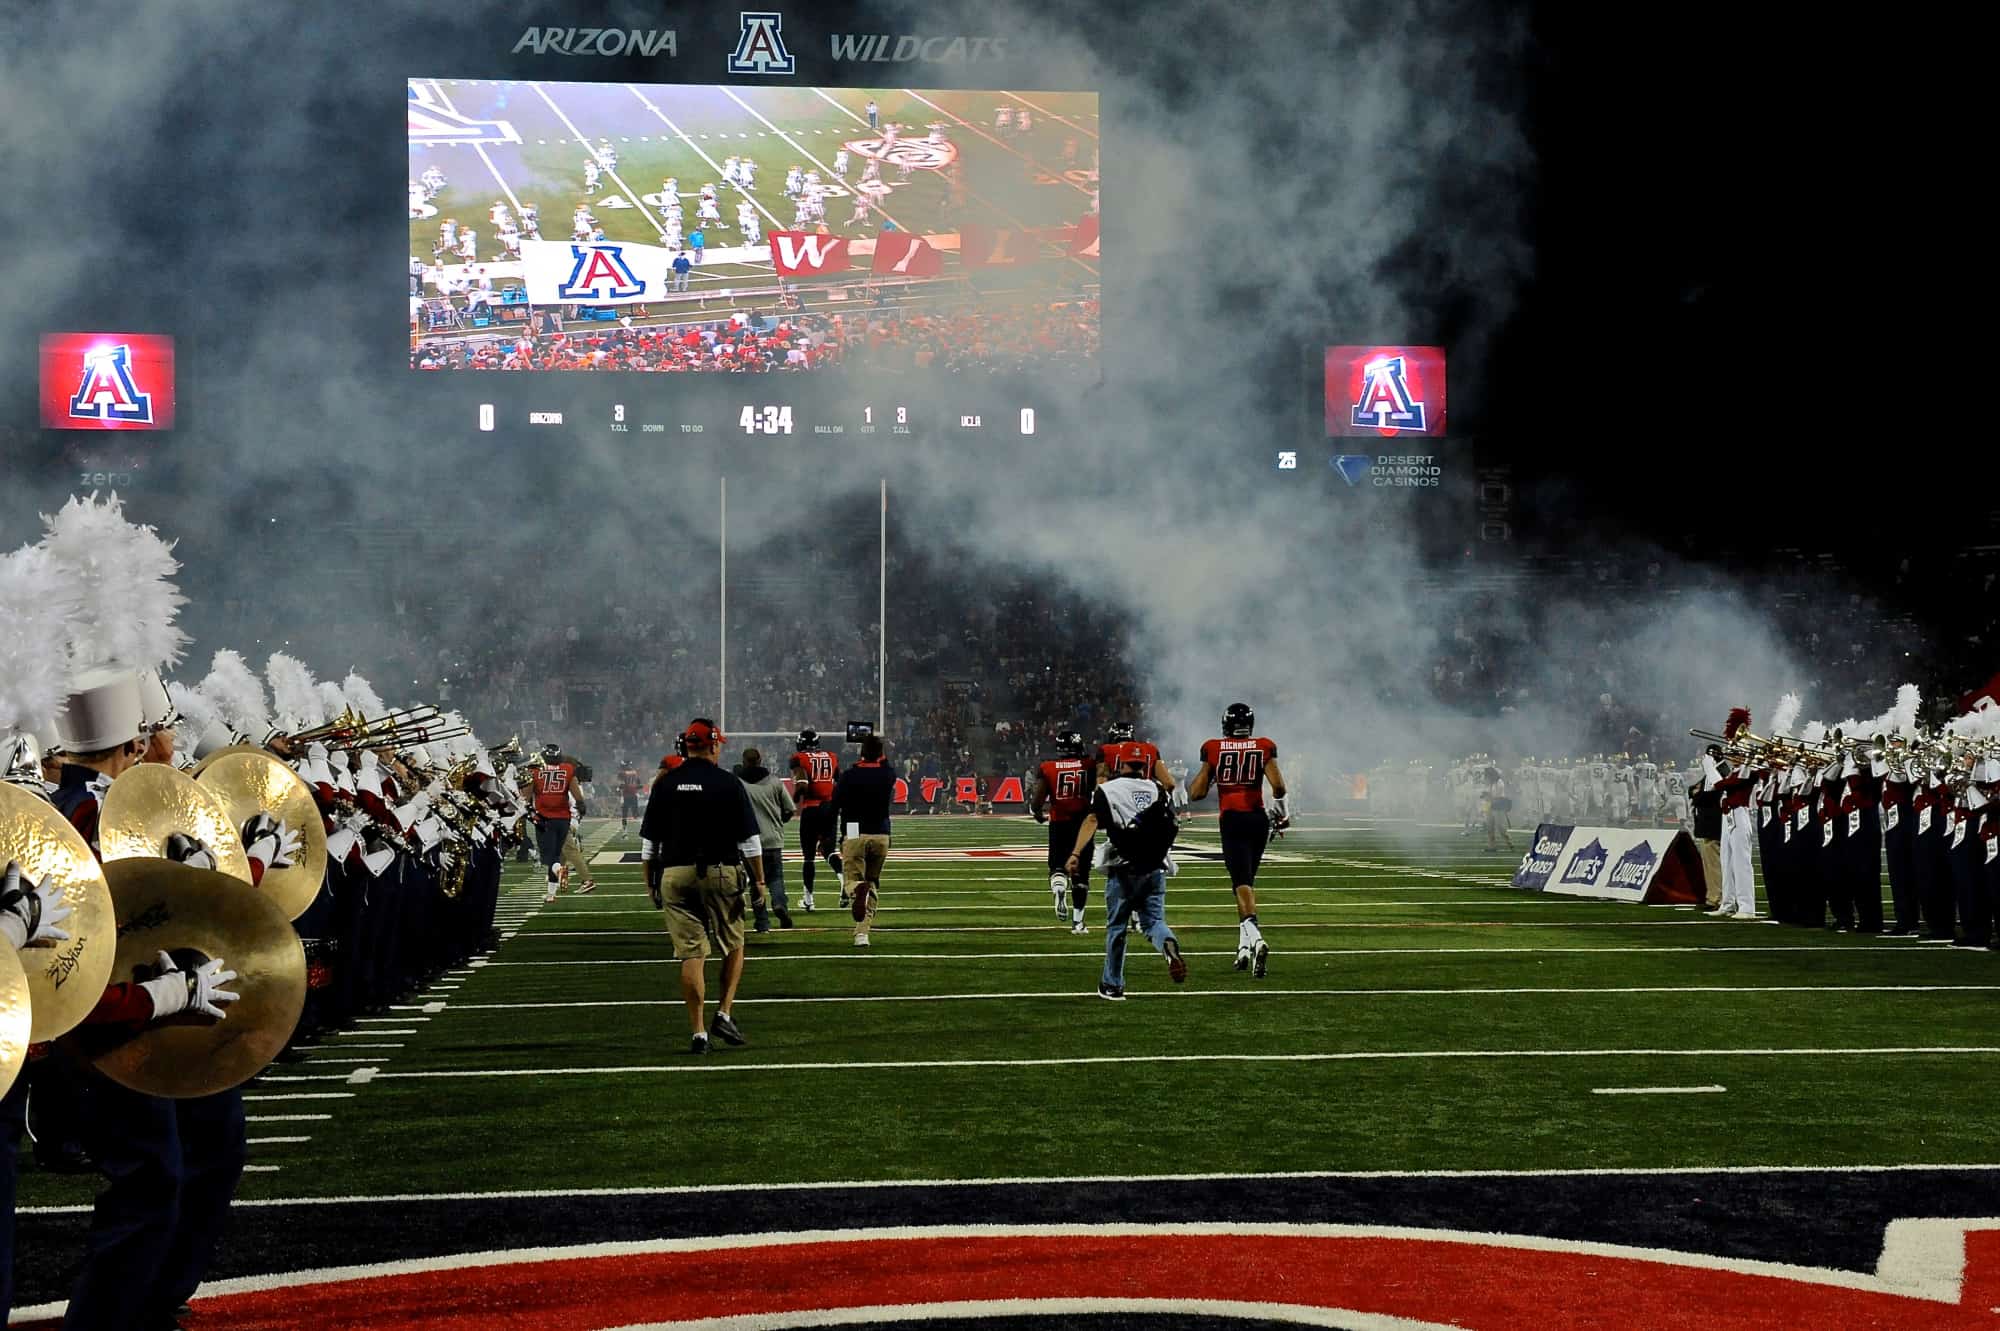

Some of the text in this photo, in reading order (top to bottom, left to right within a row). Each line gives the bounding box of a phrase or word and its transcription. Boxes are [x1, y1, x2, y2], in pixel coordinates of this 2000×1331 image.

[512, 27, 677, 57] ARIZONA
[728, 11, 796, 74] A
[830, 34, 1008, 64] WILDCATS
[69, 344, 154, 424] A
[1351, 356, 1427, 431] A
[479, 404, 494, 431] 0
[739, 405, 793, 434] 4:34
[864, 407, 872, 423] 1
[960, 415, 981, 427] UCLA
[1020, 408, 1034, 434] 0
[814, 425, 832, 433] BALL
[1370, 466, 1441, 476] DIAMOND
[1377, 455, 1435, 465] DESERT
[80, 471, 131, 486] zero
[1372, 477, 1439, 487] CASINOS
[1220, 740, 1257, 750] RICHARDS
[809, 757, 833, 782] 18
[1216, 749, 1264, 786] 80
[538, 769, 567, 793] 75
[1055, 769, 1089, 800] 61
[1566, 855, 1603, 881] LOWE'S
[1611, 859, 1651, 886] LOWE'S
[44, 936, 88, 990] Zildjian
